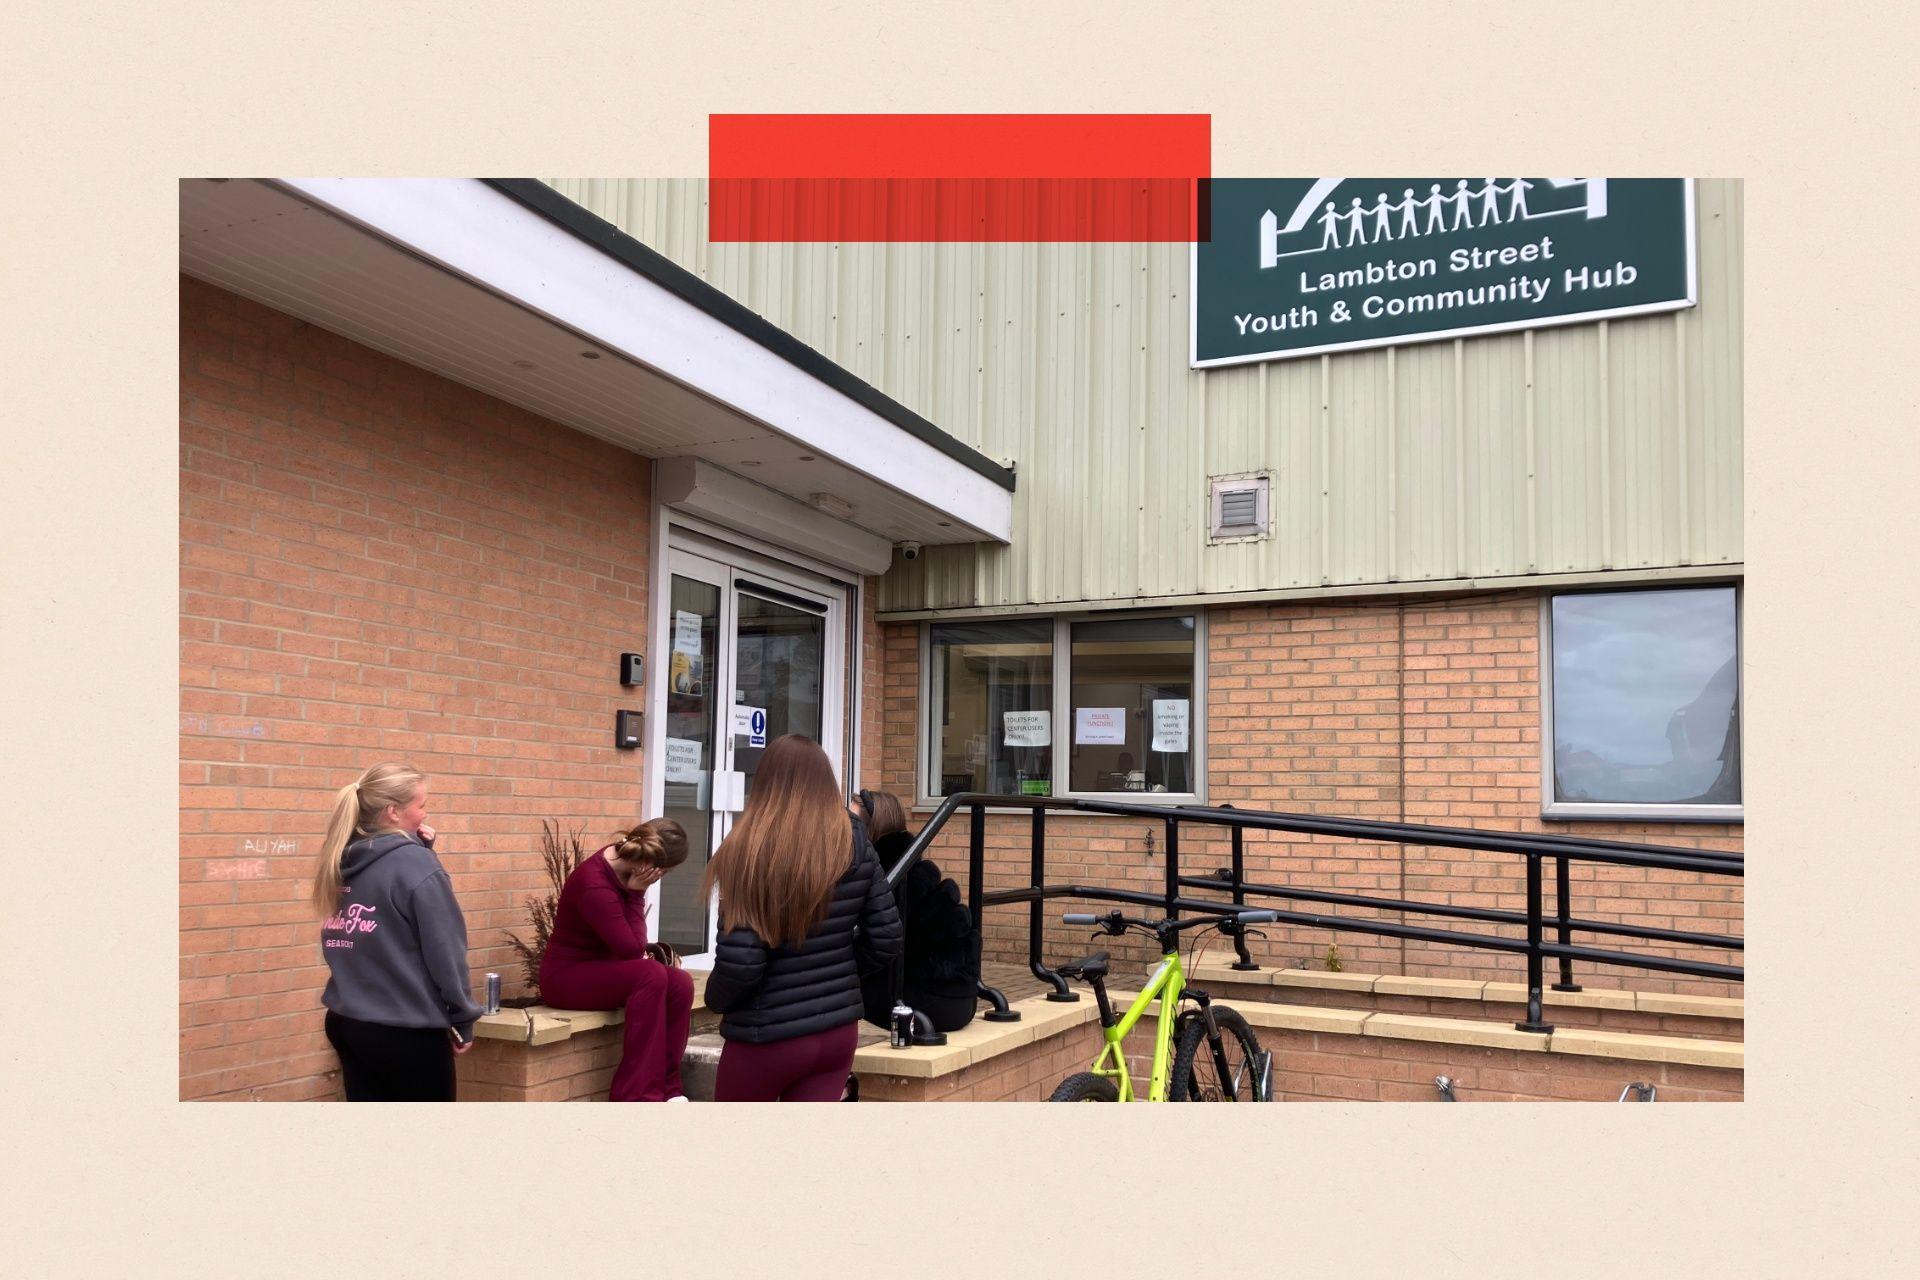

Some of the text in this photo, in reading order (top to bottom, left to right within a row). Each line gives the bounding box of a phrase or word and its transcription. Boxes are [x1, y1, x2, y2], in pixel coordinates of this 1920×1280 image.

[1300, 236, 1555, 294] Lambton Street
[1233, 261, 1639, 336] Youth & Community Hub
[345, 903, 378, 934] Fox
